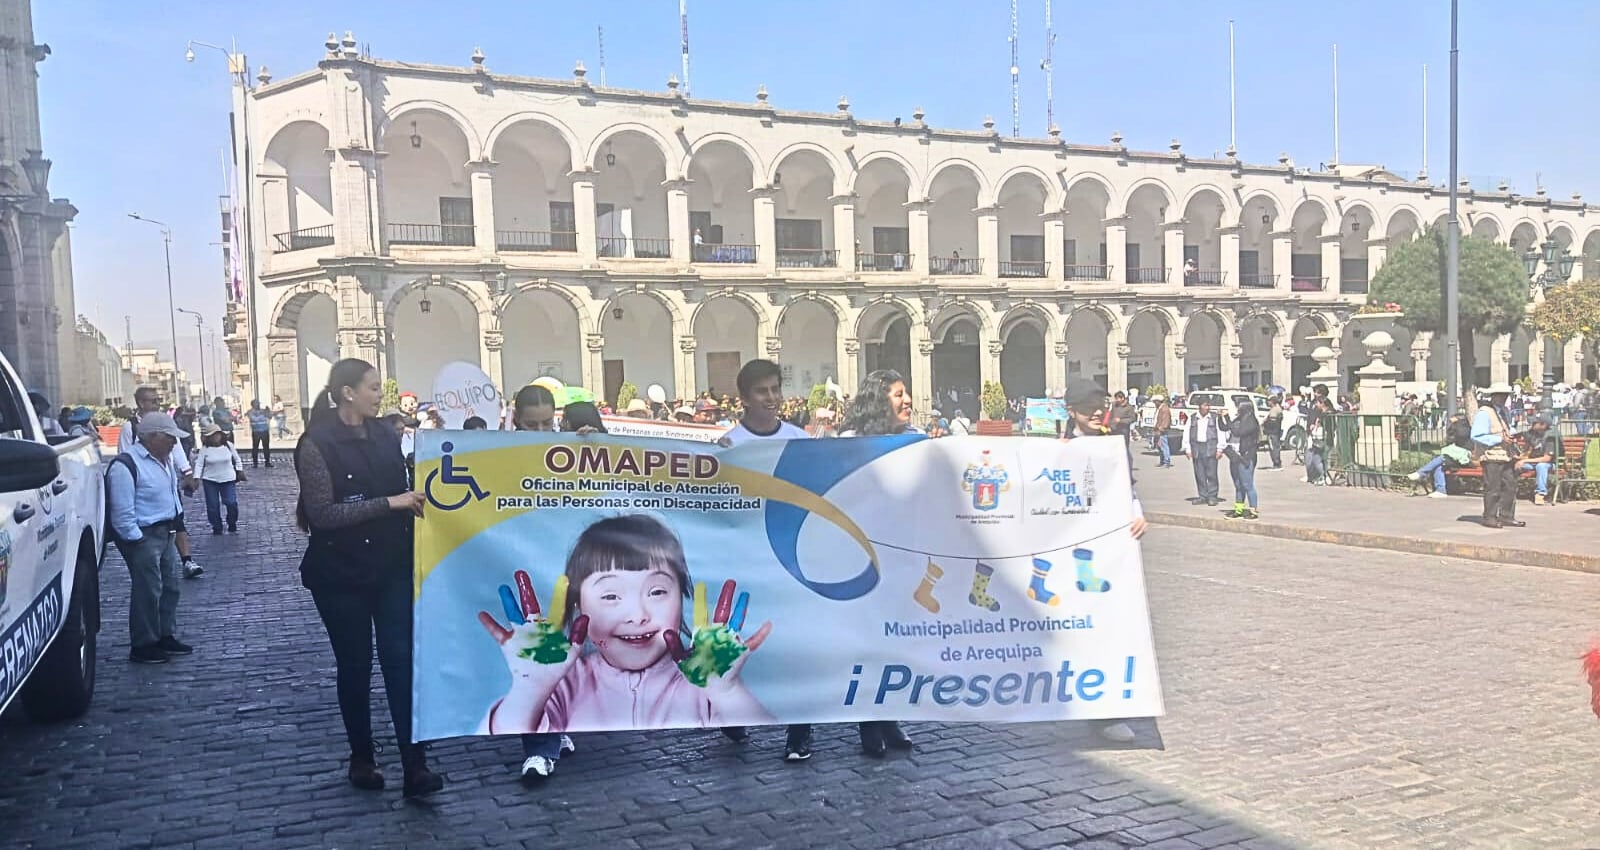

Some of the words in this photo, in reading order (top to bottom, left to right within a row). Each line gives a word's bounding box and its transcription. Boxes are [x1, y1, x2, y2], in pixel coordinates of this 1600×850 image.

[545, 446, 719, 479] OMAPED
[521, 478, 575, 491] Oficina
[578, 479, 651, 494] Municipal
[653, 481, 672, 492] de
[675, 482, 740, 495] Atención
[497, 498, 532, 510] para
[536, 495, 558, 507] las
[562, 496, 629, 508] Personas
[633, 498, 660, 508] con
[663, 497, 761, 512] Discapacidad
[884, 619, 1006, 638] Municipalidad
[1009, 614, 1093, 634] Provincial
[940, 647, 962, 662] de
[966, 644, 1043, 663] Arequipa
[874, 659, 1105, 707] Presente
[1122, 656, 1136, 699] !
